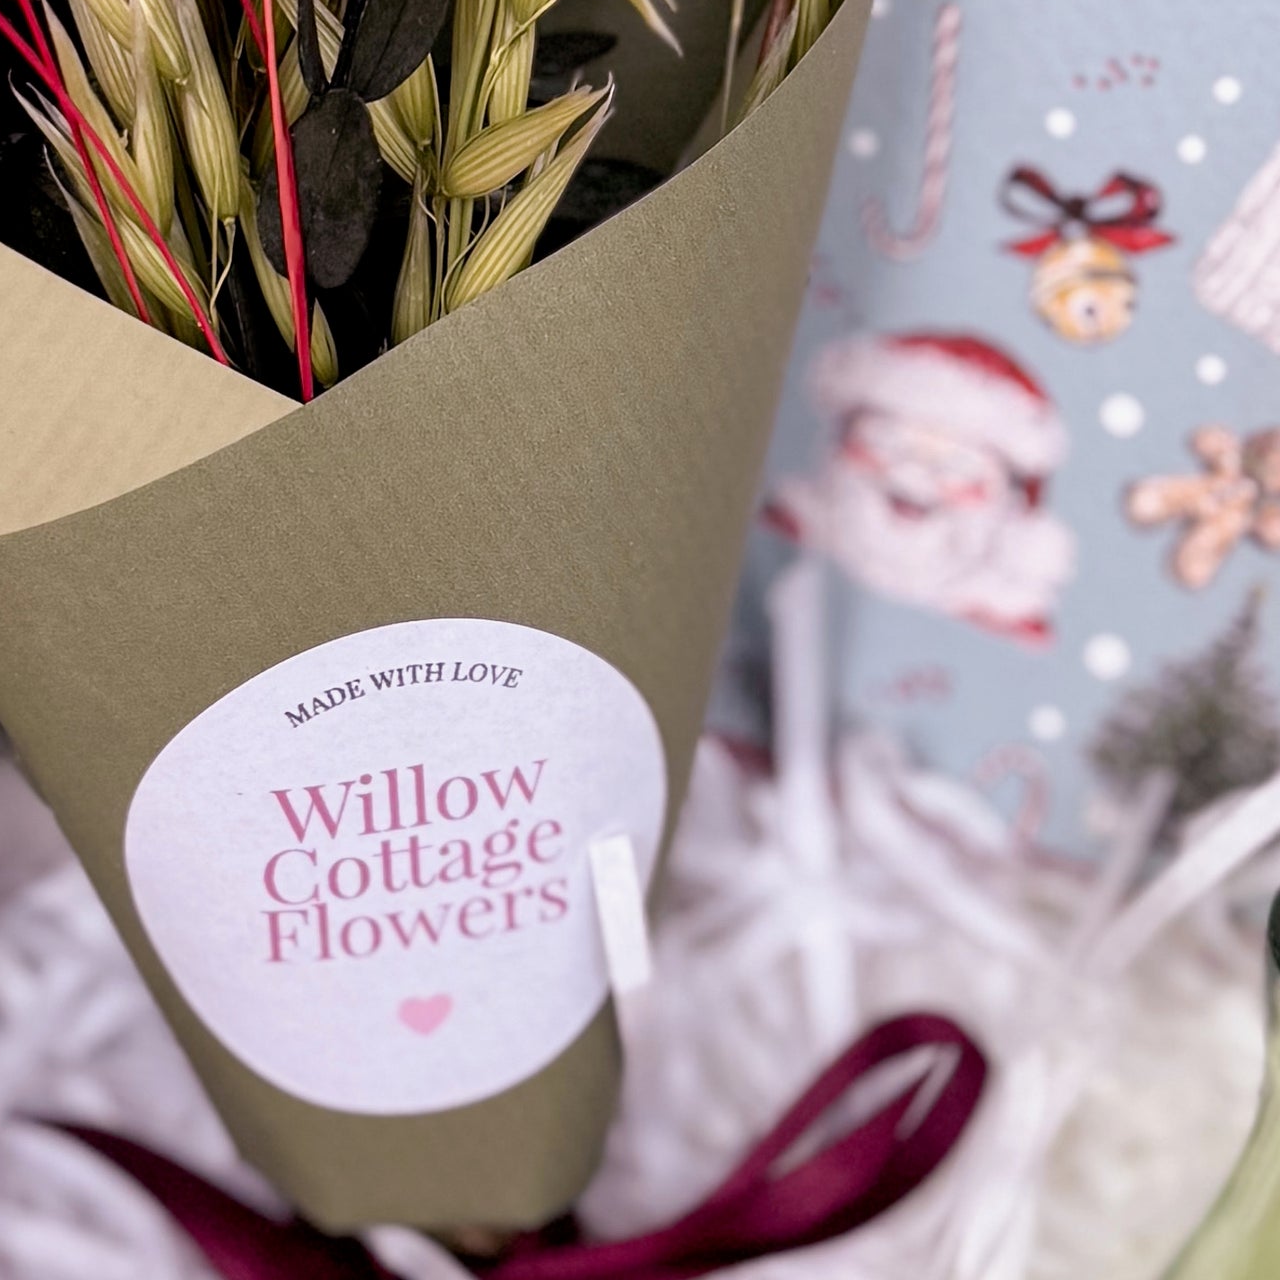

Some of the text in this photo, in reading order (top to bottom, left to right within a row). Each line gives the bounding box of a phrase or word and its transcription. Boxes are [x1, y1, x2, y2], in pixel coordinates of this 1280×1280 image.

[284, 661, 524, 729] MADE WITH LOVE
[269, 758, 549, 844] Willow
[262, 818, 564, 906] Cottage
[260, 876, 570, 964] Flowers
